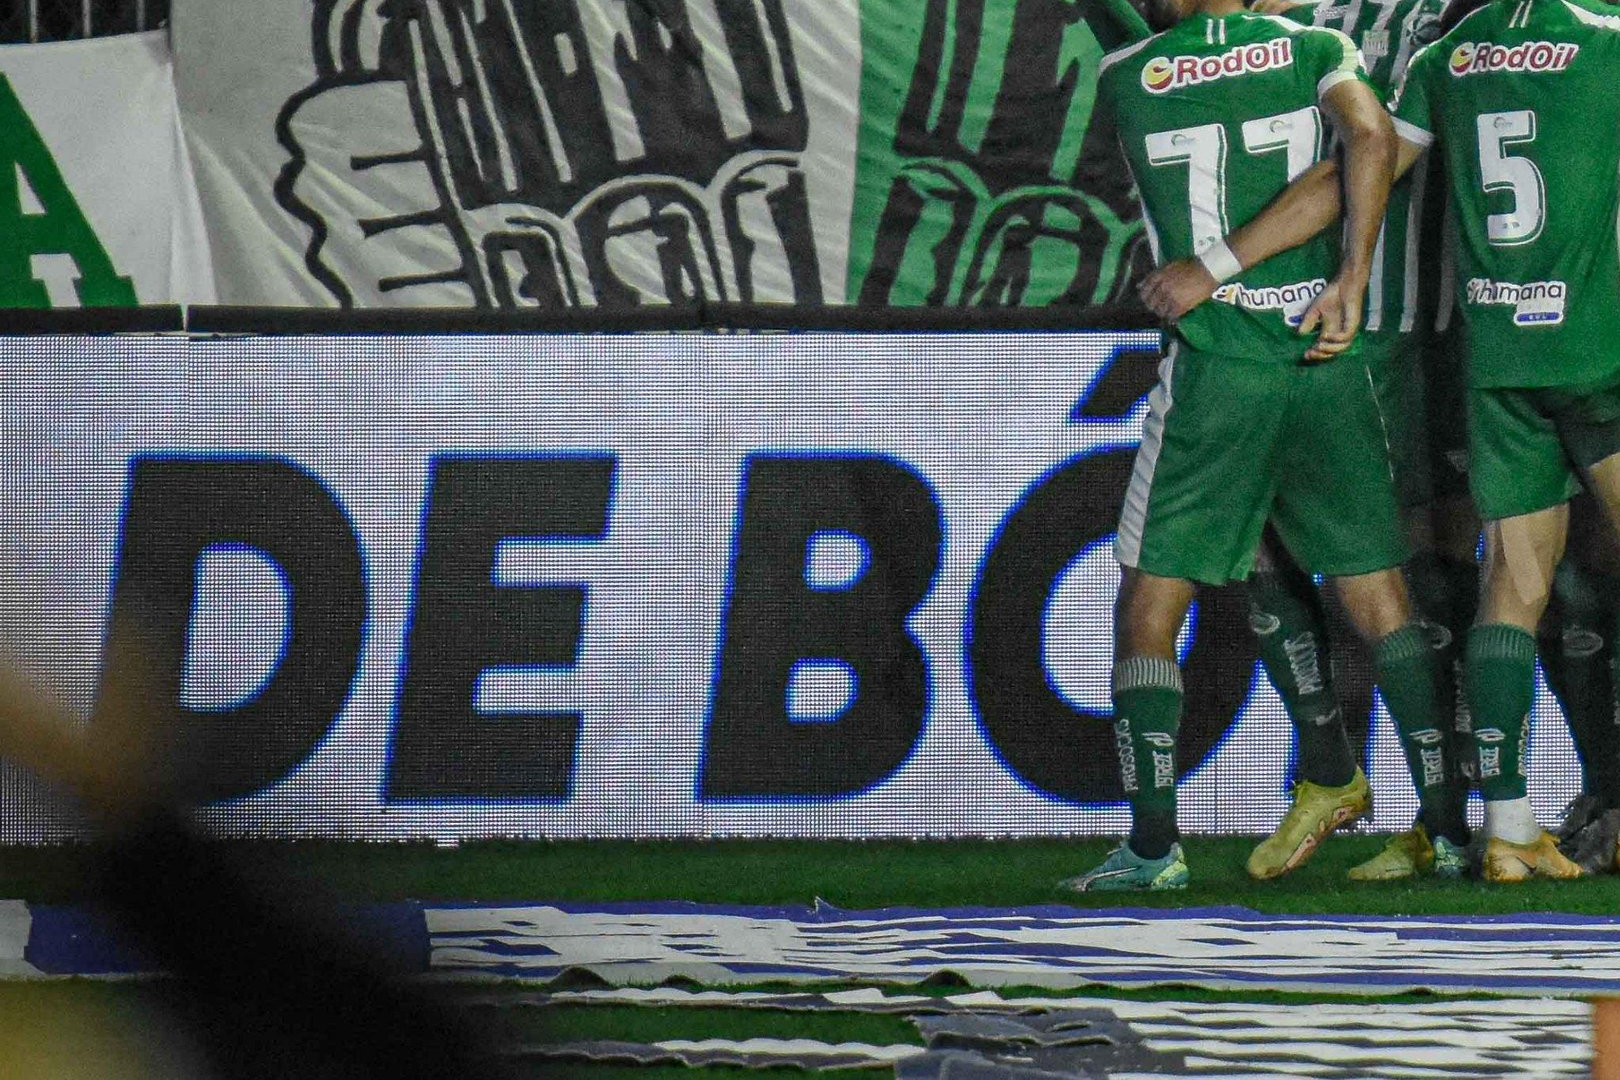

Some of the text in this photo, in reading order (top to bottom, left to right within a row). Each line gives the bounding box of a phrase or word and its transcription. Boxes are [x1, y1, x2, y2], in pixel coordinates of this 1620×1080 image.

[1175, 38, 1291, 86] RodOil
[1471, 43, 1578, 71] RodOil
[1145, 106, 1322, 258] 77
[1477, 110, 1545, 247] 5
[96, 452, 620, 806] DE
[1113, 717, 1139, 793] PROSOCKS
